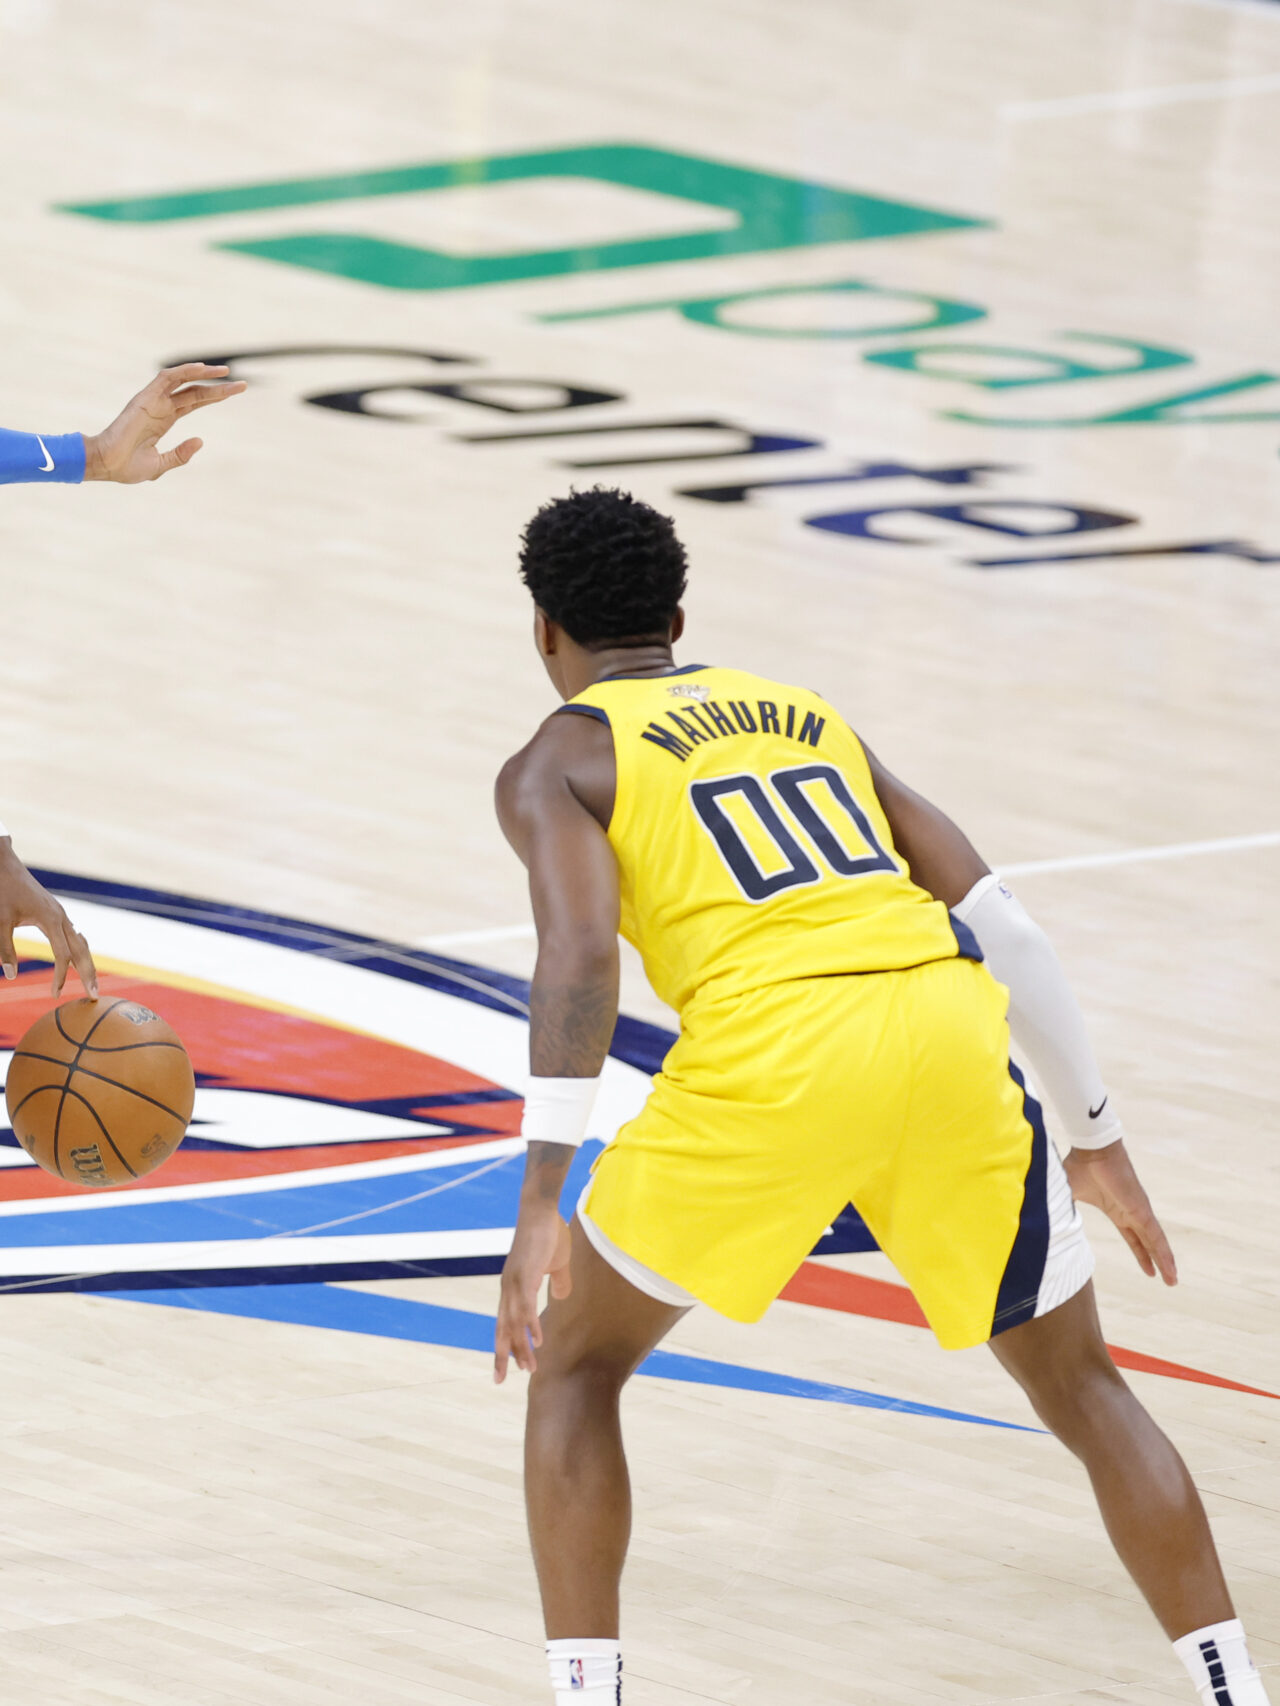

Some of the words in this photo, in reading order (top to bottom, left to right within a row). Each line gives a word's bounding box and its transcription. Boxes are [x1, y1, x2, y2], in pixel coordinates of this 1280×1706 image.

[160, 344, 1280, 567] Center
[641, 701, 825, 762] MATHURIN
[688, 762, 903, 904] 00
